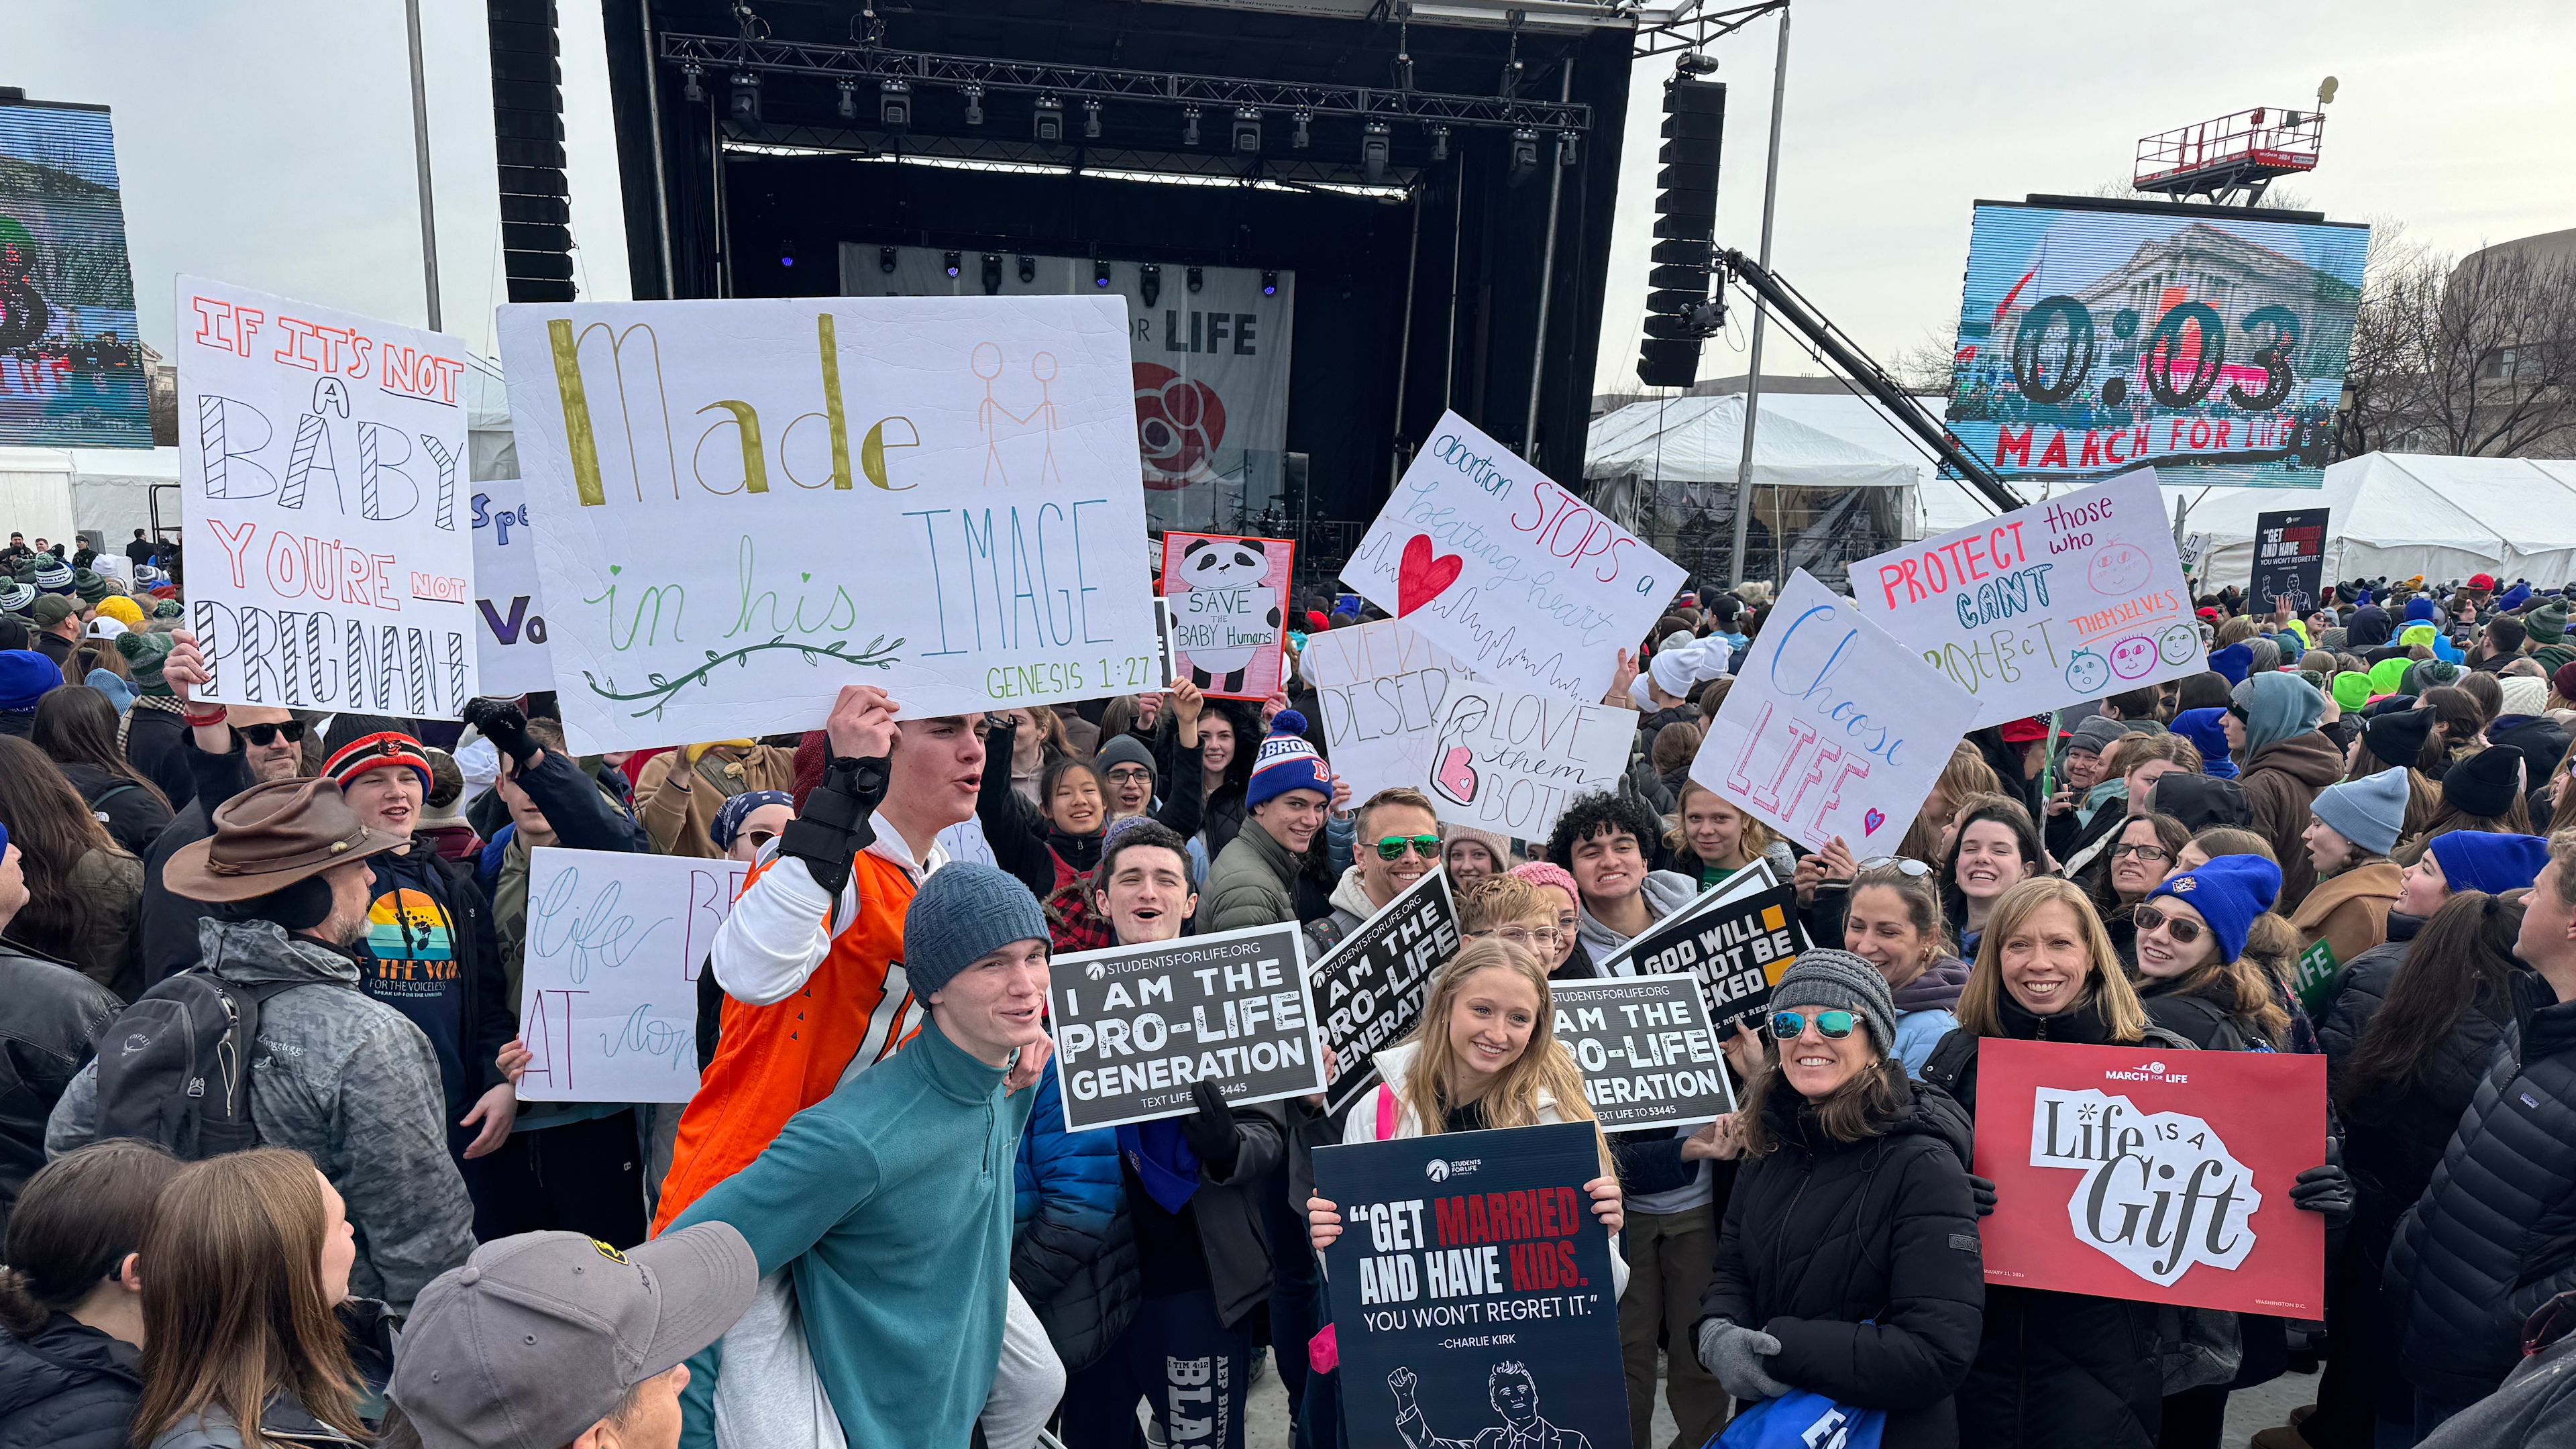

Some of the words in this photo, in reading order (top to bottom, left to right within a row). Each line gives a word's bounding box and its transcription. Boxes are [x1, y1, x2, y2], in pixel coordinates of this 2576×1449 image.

[193, 296, 264, 357] IF
[274, 316, 372, 378] IT'S
[382, 343, 464, 402] NOT
[1165, 310, 1256, 355] LIFE
[2013, 295, 2300, 411] 0:03
[313, 376, 350, 418] A
[547, 313, 919, 506] Made
[199, 395, 463, 530] BABY
[1994, 424, 2151, 467] MARCH
[2169, 418, 2231, 450] FOR
[2245, 415, 2295, 447] LIFE
[1433, 435, 1513, 501] abortion
[1511, 482, 1635, 582] STOPS
[1636, 575, 1654, 596] a
[207, 519, 400, 611] YOU'RE
[411, 571, 467, 602] NOT
[1879, 521, 2027, 610] PROTECT
[2043, 497, 2112, 534] those
[2049, 532, 2093, 554] who
[2261, 543, 2277, 557] AND
[2279, 541, 2299, 556] HAVE
[583, 565, 684, 651] in
[723, 535, 856, 638] his
[902, 499, 1114, 656] IMAGE
[1189, 590, 1251, 614] SAVE
[1956, 563, 2053, 629] CANT
[1211, 614, 1228, 623] THE
[1527, 571, 1613, 647] heart
[2068, 589, 2179, 636] THEMSELVES
[195, 601, 469, 716] PREGNANT
[1179, 625, 1218, 646] BABY
[1227, 627, 1276, 645] Humans!
[986, 663, 1083, 700] GENESIS
[1099, 656, 1150, 689] 1:27
[1771, 599, 1904, 766] Choose
[1491, 692, 1600, 762] LOVE
[1477, 745, 1612, 784] them
[1727, 700, 1870, 847] LIFE
[1107, 942, 1261, 975] STUDENTSFORLIFE.ORG
[1325, 894, 1422, 978] STUDENTSFORLIFE.ORG
[1330, 954, 1374, 1008] AM
[1381, 900, 1440, 957] THE
[1644, 939, 1697, 975] GOD
[1699, 914, 1764, 949] WILL
[1689, 947, 1743, 985] NOT
[1752, 929, 1794, 964] BE
[370, 978, 388, 990] FOR
[390, 980, 407, 991] THE
[408, 981, 446, 991] VOICELESS
[377, 959, 418, 980] THE
[1066, 988, 1079, 1016] I
[1103, 975, 1173, 1012] AM
[1193, 958, 1283, 996] THE
[1551, 985, 1670, 1004] STUDENTSFORLIFE.ORG
[2294, 947, 2332, 991] IFE
[522, 989, 590, 1089] AT
[1059, 990, 1305, 1065] PRO-LIFE
[1399, 1027, 1409, 1038] TO
[1553, 1006, 1607, 1034] AM
[1620, 1000, 1692, 1028] THE
[1723, 1012, 1746, 1026] ROSE
[1072, 1036, 1305, 1101] GENERATION
[2106, 1070, 2149, 1081] MARCH
[2165, 1073, 2188, 1083] LIFE
[1141, 1095, 1167, 1108] TEXT
[1170, 1091, 1193, 1104] LIFE
[1219, 1082, 1248, 1096] 3445
[1595, 1110, 1613, 1121] TEXT
[1615, 1108, 1633, 1120] LIFE
[1634, 1108, 1648, 1118] TO
[1649, 1104, 1676, 1116] 53445
[2041, 1100, 2144, 1161] Life
[2155, 1122, 2178, 1141] IS
[2187, 1132, 2206, 1150] A
[1451, 1159, 1481, 1167] STUDENTS
[1349, 1198, 1425, 1252] "GET
[1434, 1185, 1580, 1246] MARRIED
[2086, 1153, 2246, 1276] Gift
[1358, 1254, 1419, 1305] AND
[1426, 1246, 1503, 1299] HAVE
[1509, 1240, 1589, 1292] KIDS.
[1363, 1309, 1407, 1333] YOU
[1411, 1303, 1481, 1328] WON'T
[1487, 1297, 1562, 1322] REGRET
[1568, 1293, 1598, 1316] IT."
[2255, 1298, 2293, 1308] WASHINGTON
[1174, 1361, 1189, 1369] TIM
[1192, 1360, 1209, 1368] 4:12
[1438, 1336, 1490, 1350] -CHARLIE
[1492, 1334, 1516, 1346] KIRK
